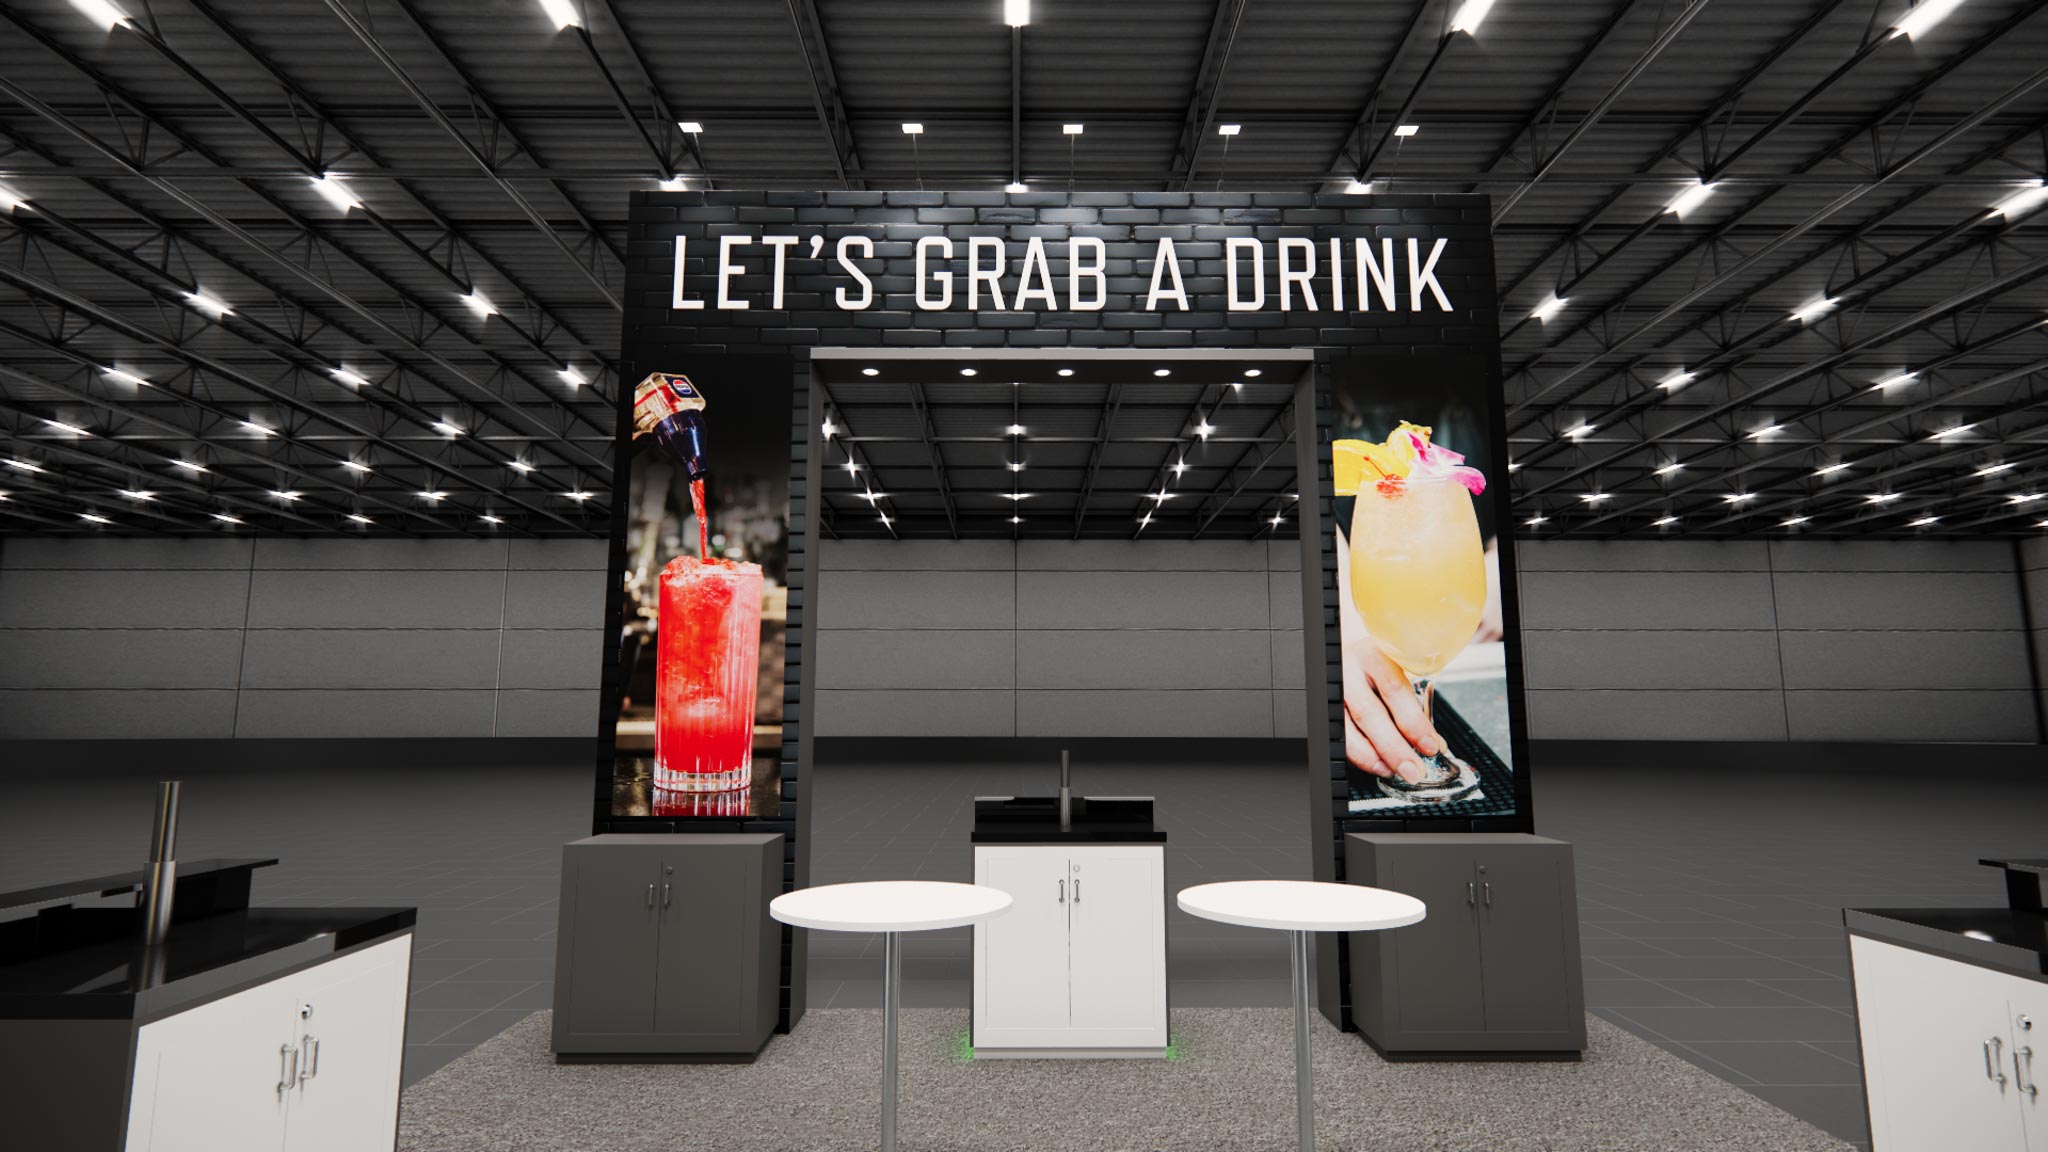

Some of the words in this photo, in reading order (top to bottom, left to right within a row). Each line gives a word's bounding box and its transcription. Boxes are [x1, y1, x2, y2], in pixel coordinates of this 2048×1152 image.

[672, 234, 875, 311] LET’S
[915, 235, 1108, 312] GRAB
[1145, 236, 1190, 312] A
[1225, 236, 1454, 313] DRINK
